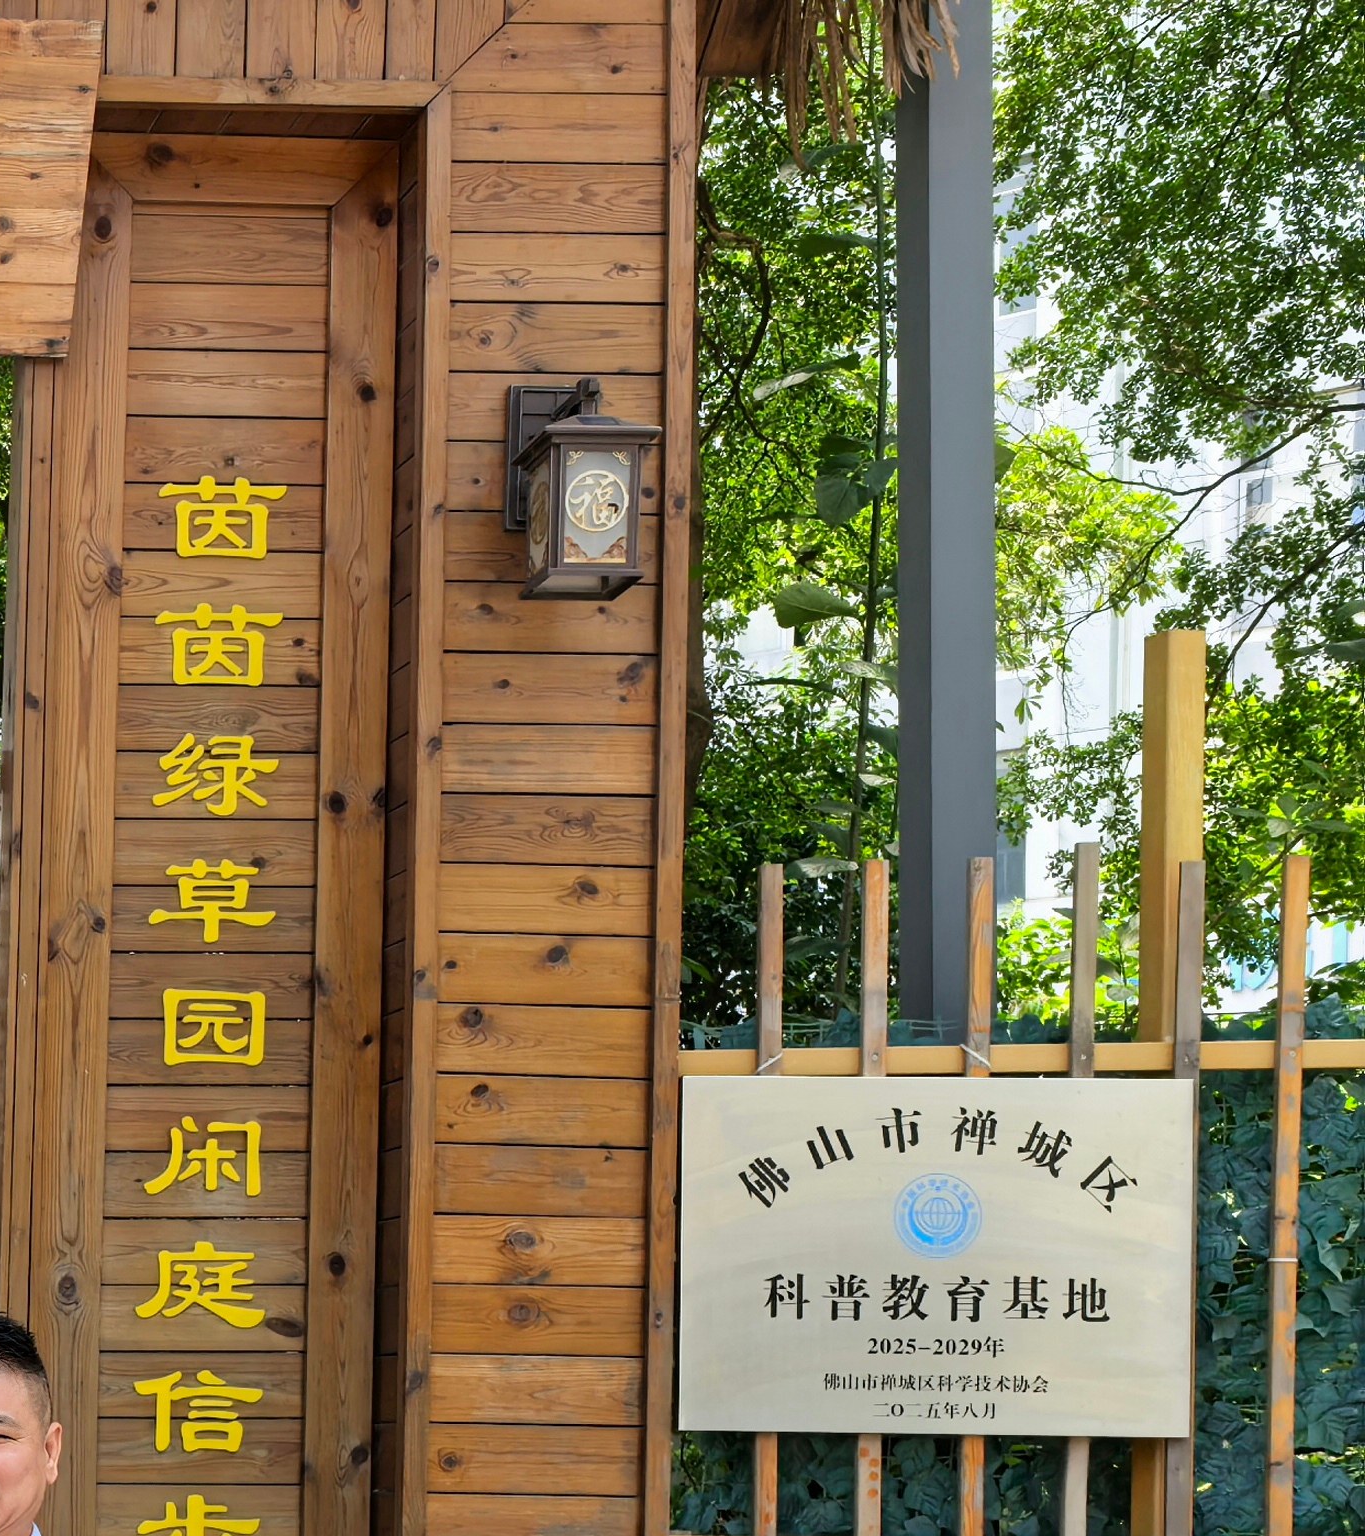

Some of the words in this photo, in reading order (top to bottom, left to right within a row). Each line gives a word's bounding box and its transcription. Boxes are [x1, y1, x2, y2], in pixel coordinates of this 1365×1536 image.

[738, 1106, 1138, 1213] 佛山市禅城区
[763, 1273, 1111, 1323] 科普教育基地
[867, 1335, 1005, 1358] 2025-2029年
[823, 1372, 1049, 1394] 佛山市禅城区科学技术协会
